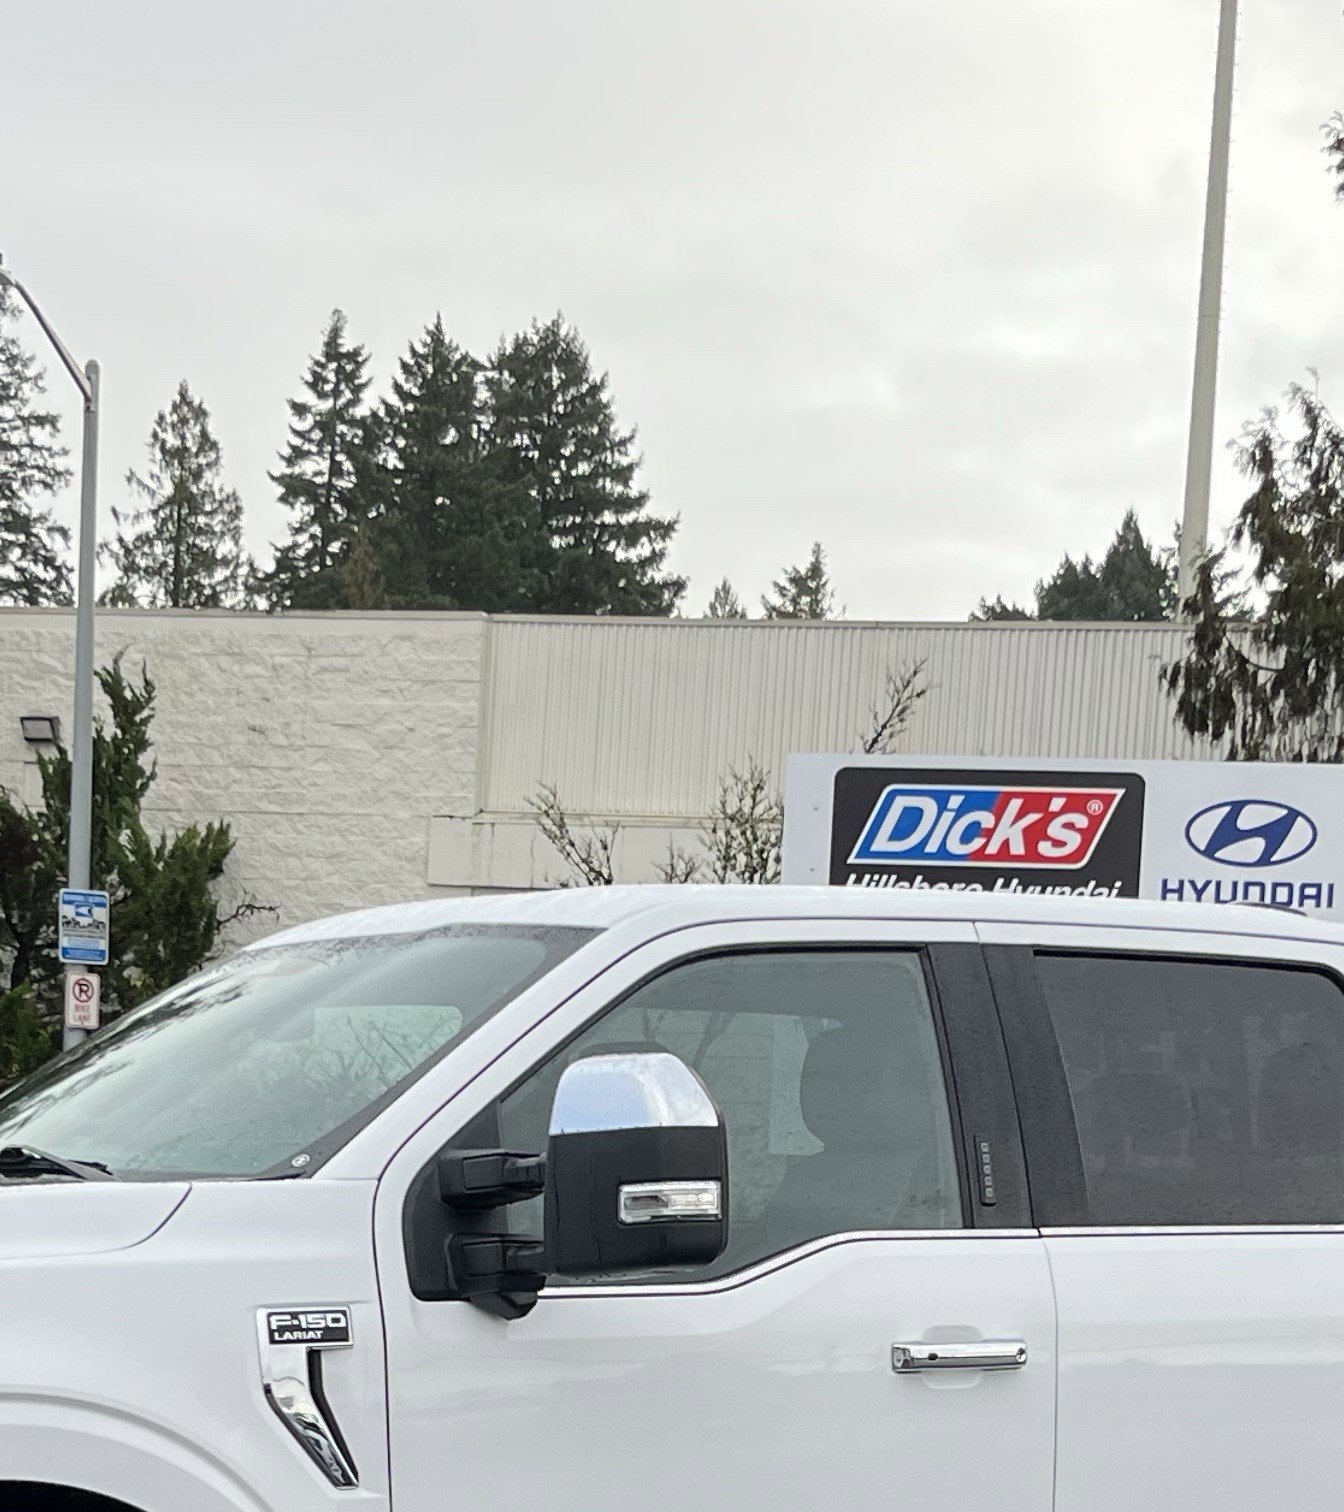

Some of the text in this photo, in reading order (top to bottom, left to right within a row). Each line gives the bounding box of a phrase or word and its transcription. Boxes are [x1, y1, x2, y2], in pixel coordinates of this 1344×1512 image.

[869, 794, 1090, 859] Dick's
[1160, 878, 1334, 908] HYUNDAI
[270, 1312, 346, 1329] F-150
[274, 1329, 324, 1341] LARIAT
